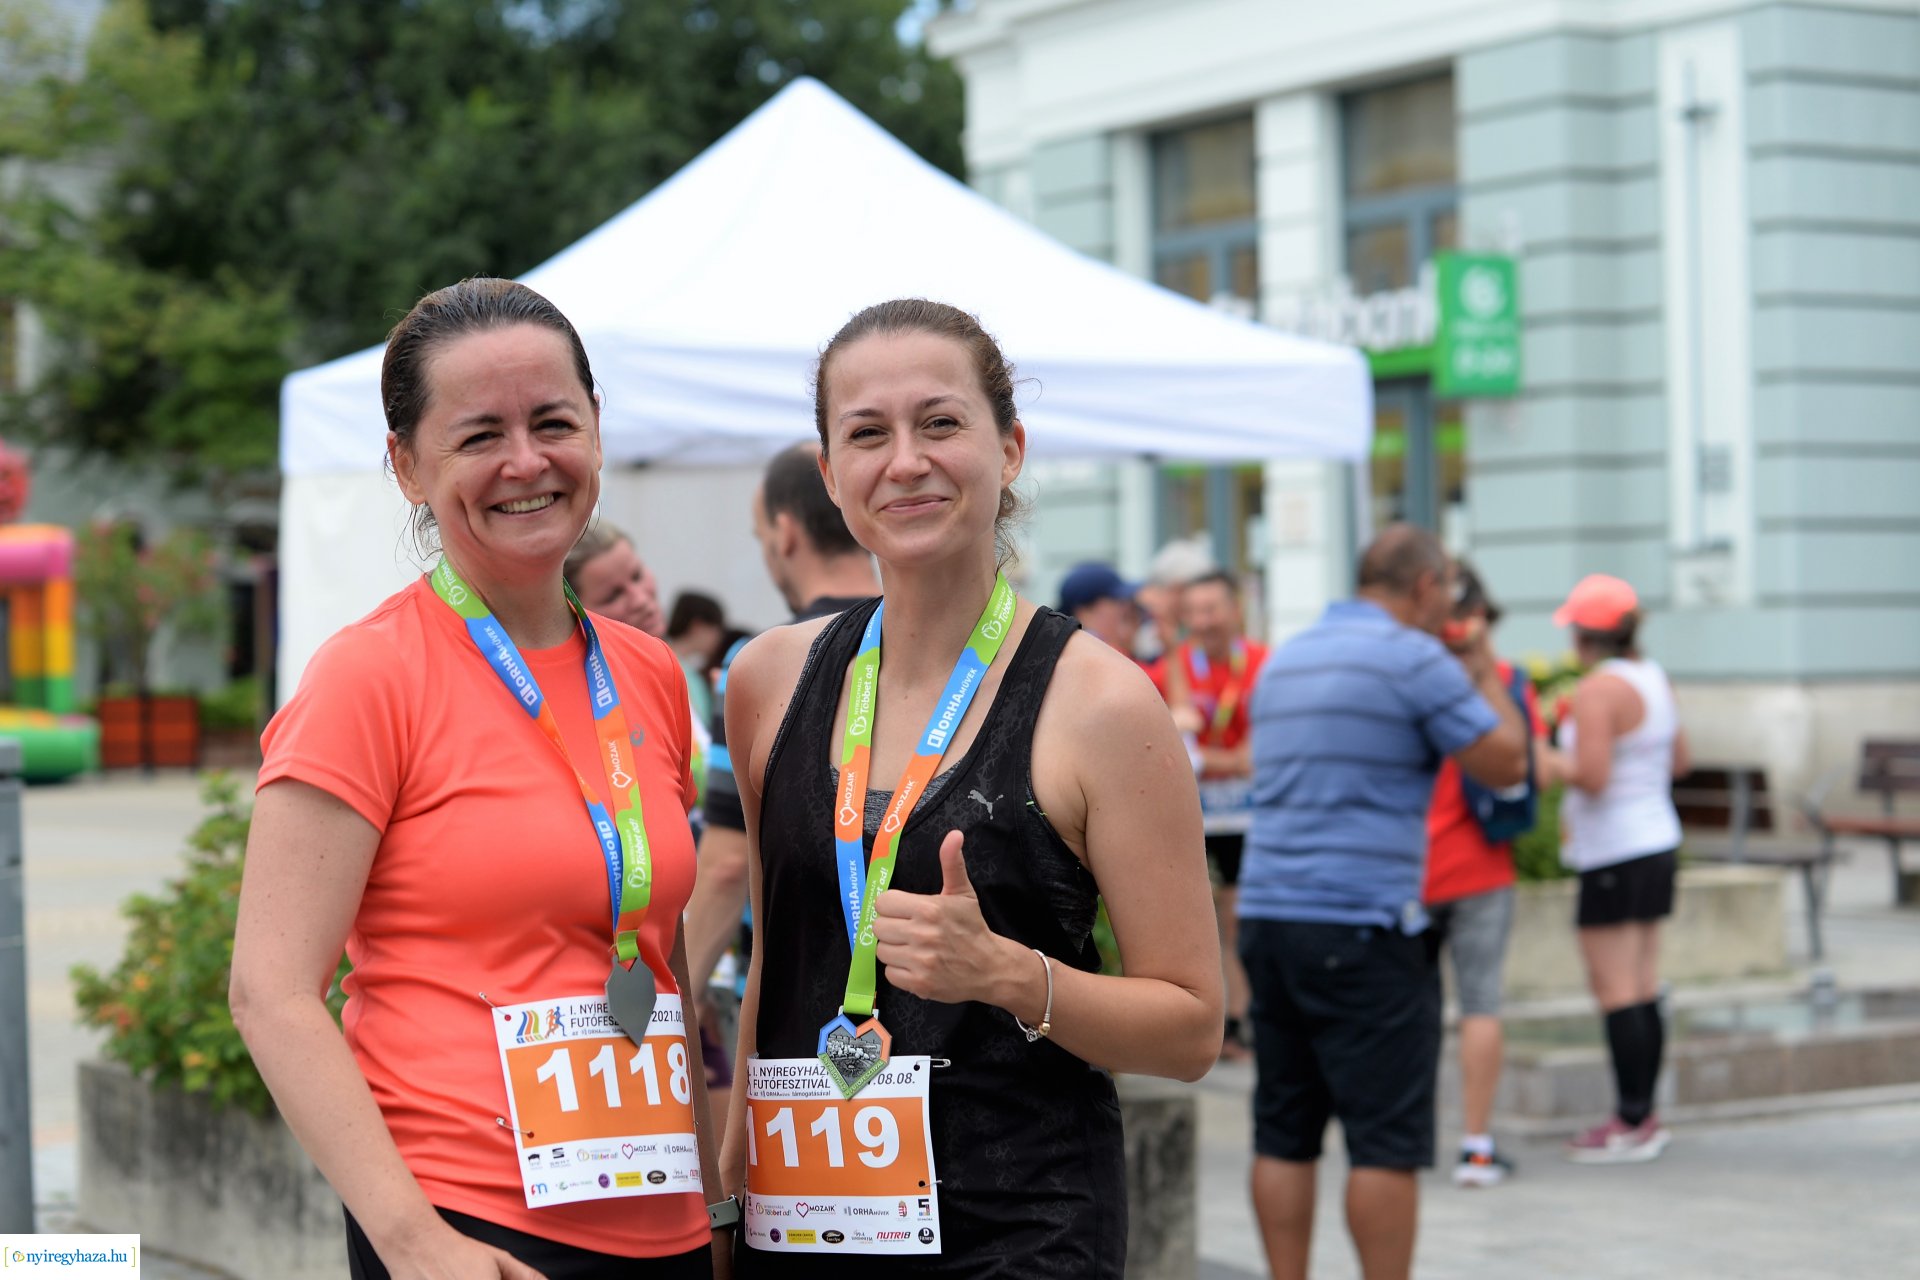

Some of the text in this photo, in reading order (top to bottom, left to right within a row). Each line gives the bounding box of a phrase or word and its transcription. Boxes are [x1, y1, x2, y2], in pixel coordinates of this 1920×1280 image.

[608, 741, 622, 773] MOZAIK
[846, 772, 855, 807] MOZAIK
[894, 780, 915, 816] MOZAIK
[580, 1002, 608, 1014] NYÍRE
[536, 1042, 690, 1113] 1118
[760, 1065, 829, 1077] NYÍREGYHÁZ
[866, 1073, 916, 1086] .08.08.
[753, 1077, 831, 1090] FUTÓFESZTIVÁL
[792, 1090, 831, 1098] támogatásával
[746, 1105, 900, 1168] 1119
